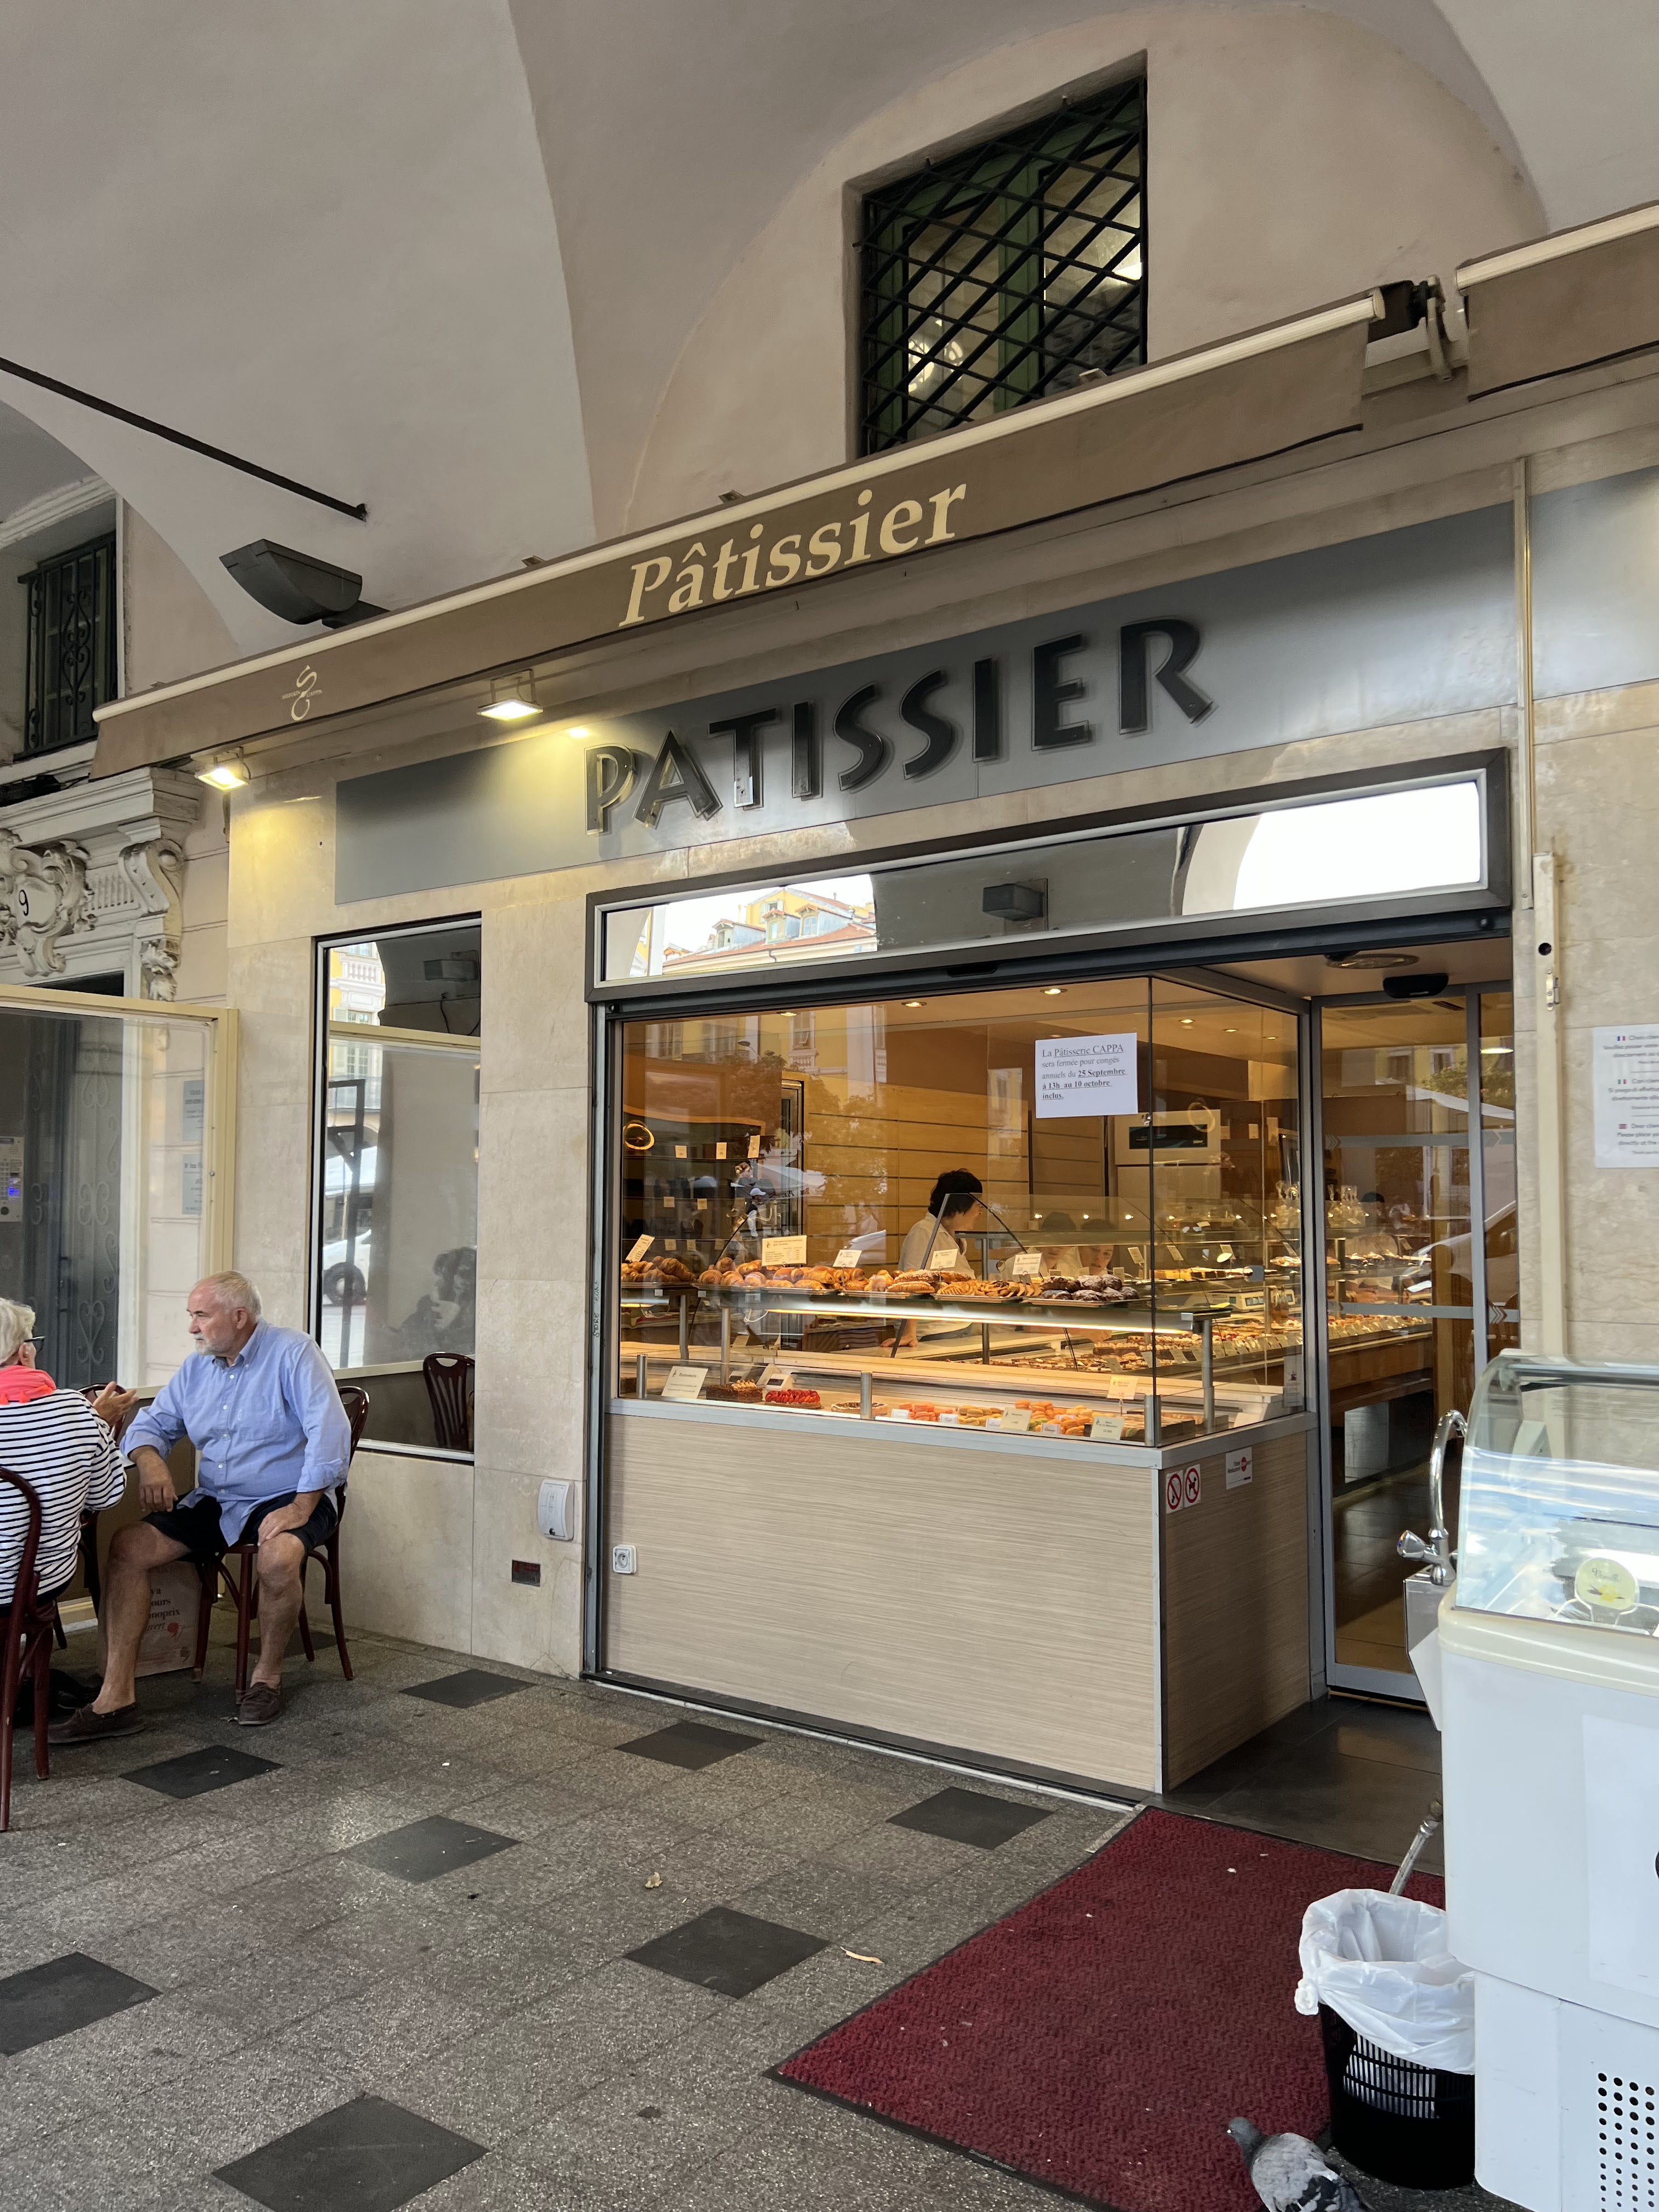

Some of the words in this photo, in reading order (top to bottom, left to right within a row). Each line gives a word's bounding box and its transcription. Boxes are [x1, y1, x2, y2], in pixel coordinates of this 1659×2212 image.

[618, 483, 967, 627] Pâtissier
[584, 618, 1213, 835] PATISSIER
[19, 889, 29, 916] 9
[1042, 1049, 1052, 1058] La
[1054, 1046, 1091, 1057] Pâtisserie
[1092, 1043, 1124, 1053] CAPPA
[1080, 1059, 1095, 1067] pour
[1096, 1056, 1120, 1065] congés
[1042, 1071, 1066, 1079] annuels
[1087, 1068, 1126, 1077] Septembre
